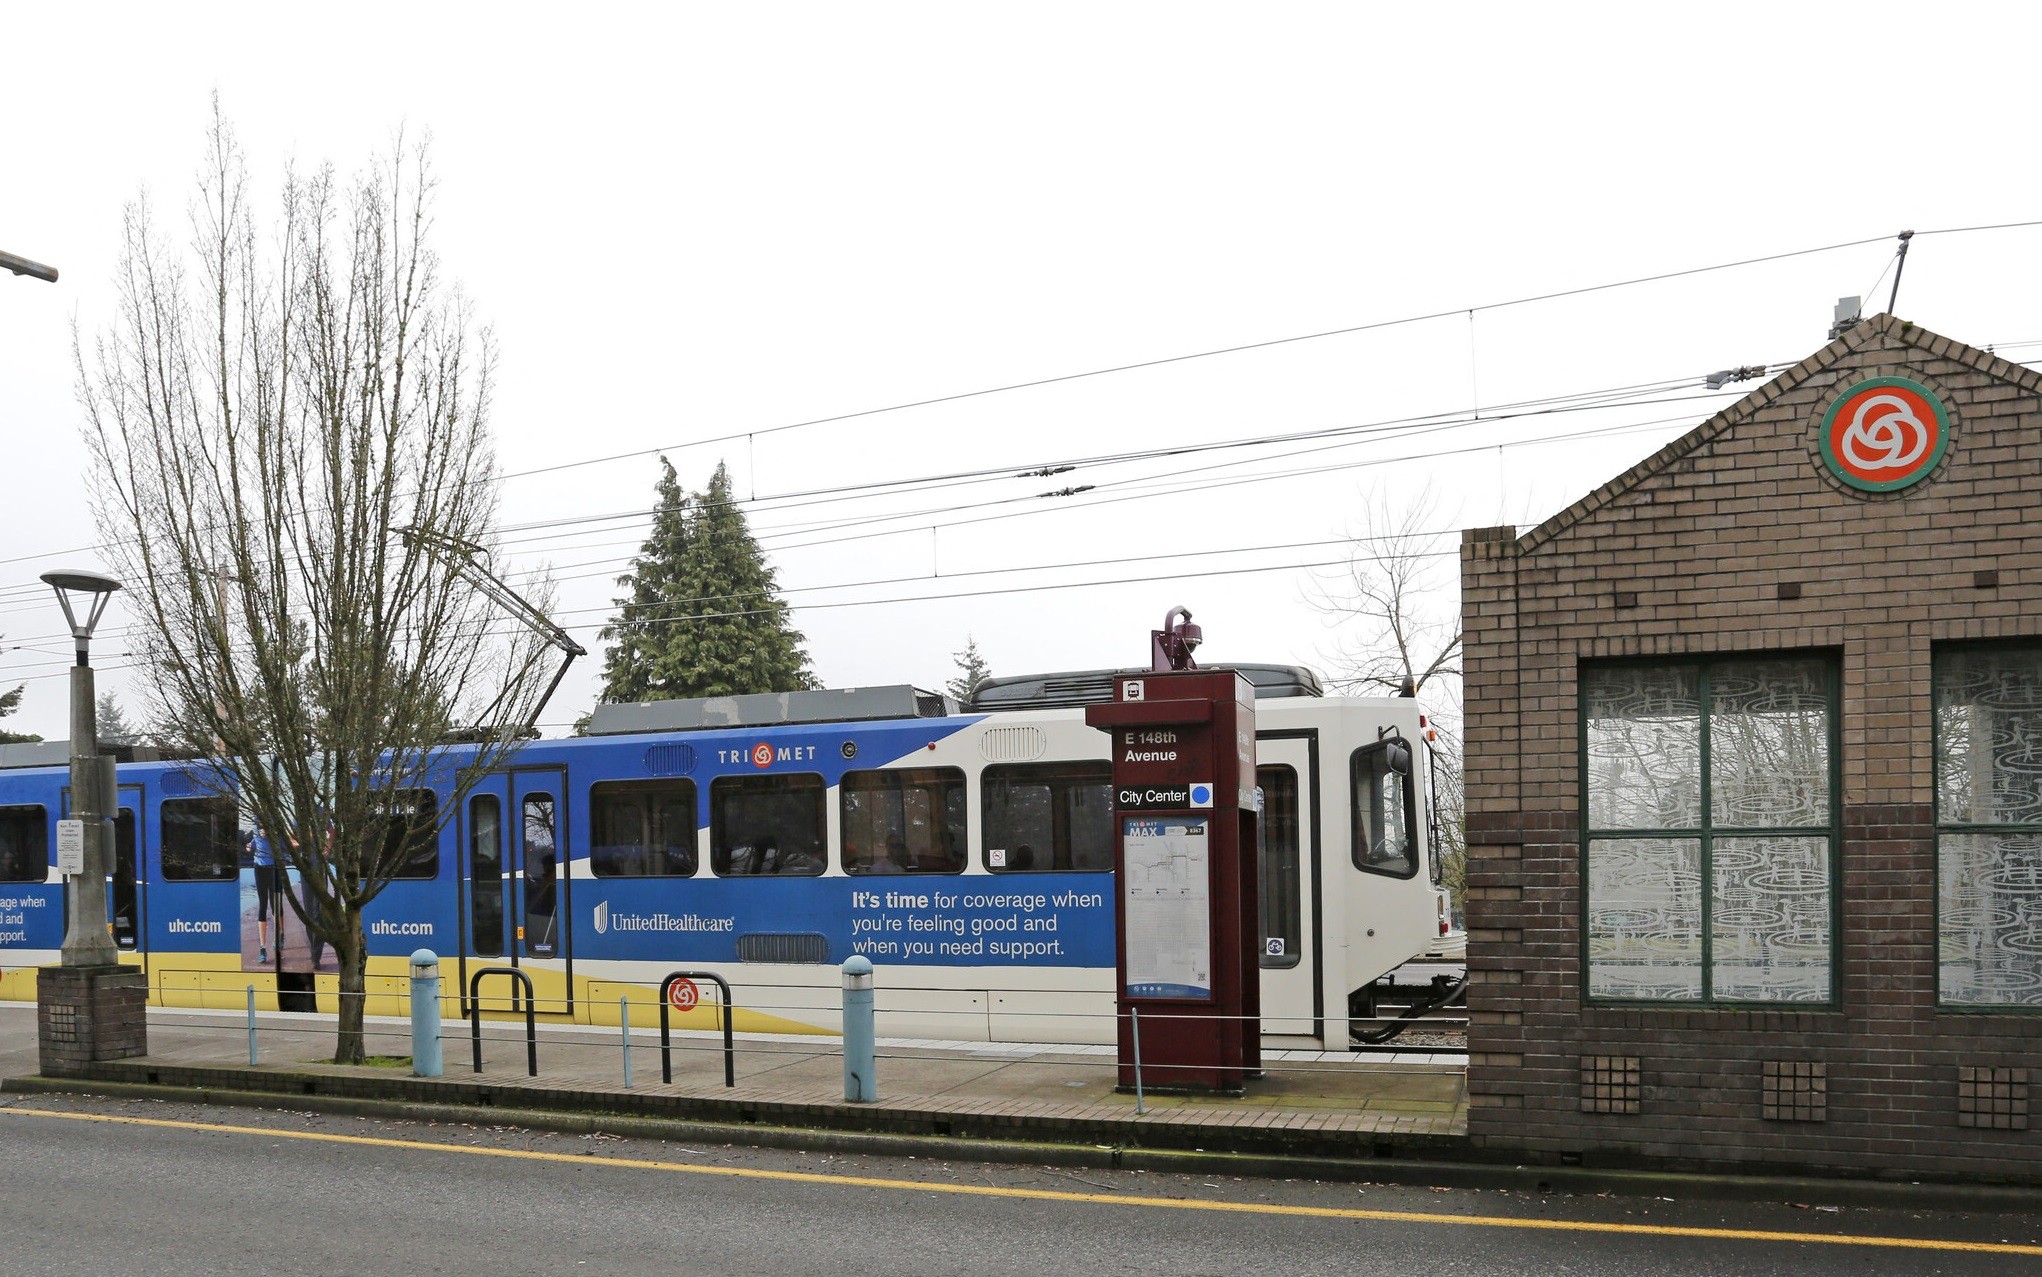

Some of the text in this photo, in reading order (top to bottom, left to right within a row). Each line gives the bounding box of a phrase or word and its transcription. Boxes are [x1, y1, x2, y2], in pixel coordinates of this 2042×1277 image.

[1125, 731, 1177, 744] E 148th
[718, 746, 816, 764] TRI MET
[1125, 750, 1177, 762] Avenue
[1119, 789, 1187, 806] City Center
[1129, 827, 1158, 837] MAX
[20, 895, 46, 908] when
[886, 891, 929, 909] time
[934, 891, 958, 908] for
[963, 894, 1046, 912] coverage
[1052, 890, 1102, 908] when
[5, 911, 24, 924] and
[852, 914, 1057, 936] you're feeling good and
[168, 918, 221, 933] uhc.com
[371, 919, 433, 935] uhc.com
[852, 937, 1065, 959] when you need support.
